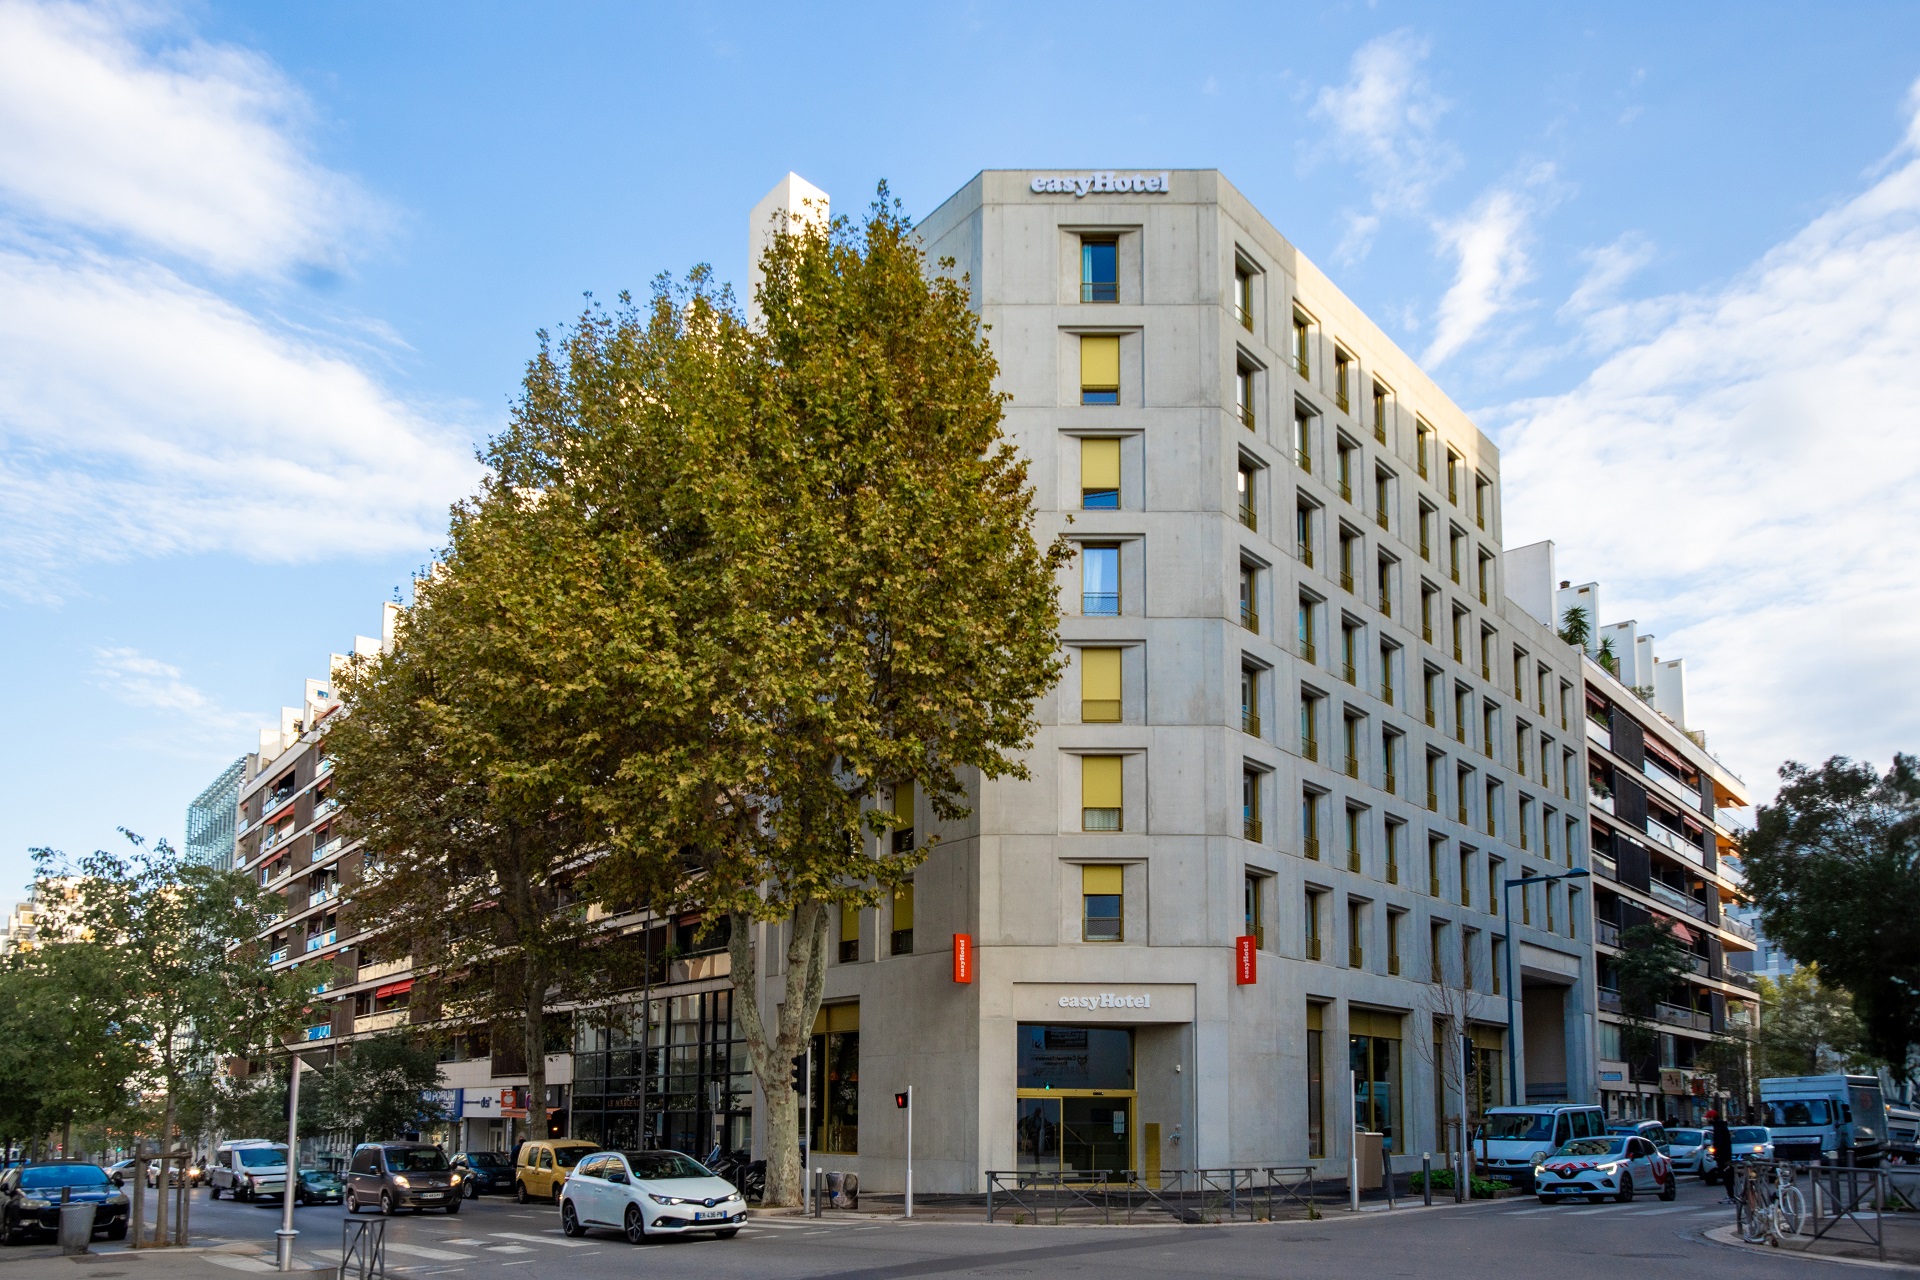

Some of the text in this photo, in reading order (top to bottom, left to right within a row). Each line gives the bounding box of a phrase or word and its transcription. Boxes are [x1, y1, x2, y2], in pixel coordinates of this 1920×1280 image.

[1030, 171, 1169, 198] easyHotel
[1242, 941, 1251, 979] easyHotel
[1058, 993, 1151, 1011] easyHotel
